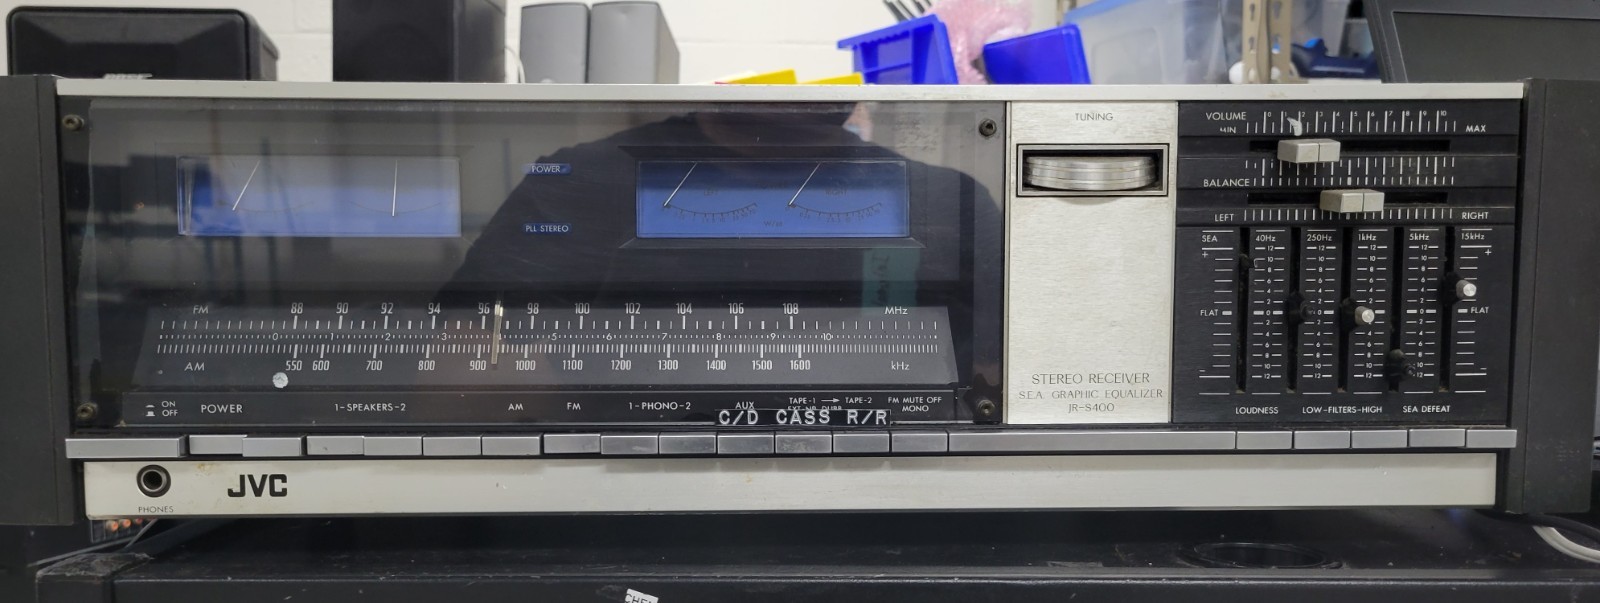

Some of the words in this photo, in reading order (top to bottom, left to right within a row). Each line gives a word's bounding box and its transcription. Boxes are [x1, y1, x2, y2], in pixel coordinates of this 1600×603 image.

[1076, 113, 1113, 121] TUNING
[1206, 112, 1246, 120] VOLUME
[531, 165, 561, 173] POWER
[1204, 179, 1249, 187] BALANCE
[193, 306, 208, 314] FM
[290, 302, 303, 314] 88
[335, 302, 349, 314] 90
[380, 302, 393, 314] 92
[427, 302, 441, 314] 94
[478, 302, 490, 314] 96
[527, 302, 540, 314] 98
[574, 302, 590, 314] 100
[625, 302, 641, 314] 102
[676, 302, 692, 314] 104
[728, 302, 744, 314] 106
[782, 302, 799, 314] 108
[185, 362, 204, 370] AM
[286, 360, 302, 370] 550
[313, 360, 329, 370] 600
[366, 360, 382, 370] 700
[418, 360, 435, 370] 800
[470, 360, 486, 370] 900
[516, 360, 535, 370] 1000
[563, 360, 583, 370] 1100
[611, 360, 631, 370] 1200
[658, 360, 678, 370] 1300
[707, 360, 726, 370] 1400
[752, 360, 772, 370] 1500
[791, 360, 810, 370] 1600
[892, 361, 909, 370] kHz
[1032, 374, 1082, 384] STEREO
[1089, 373, 1149, 383] RECEIVER
[1052, 390, 1098, 398] GRAPHIC
[1105, 389, 1162, 399] EQUALIZER
[201, 404, 242, 413] POWER
[735, 402, 755, 410] AUX
[1069, 403, 1114, 413] JR-S400
[719, 410, 760, 425] C/D
[776, 409, 830, 425] CASS
[845, 409, 886, 424] R/R
[228, 474, 287, 497] JVC
